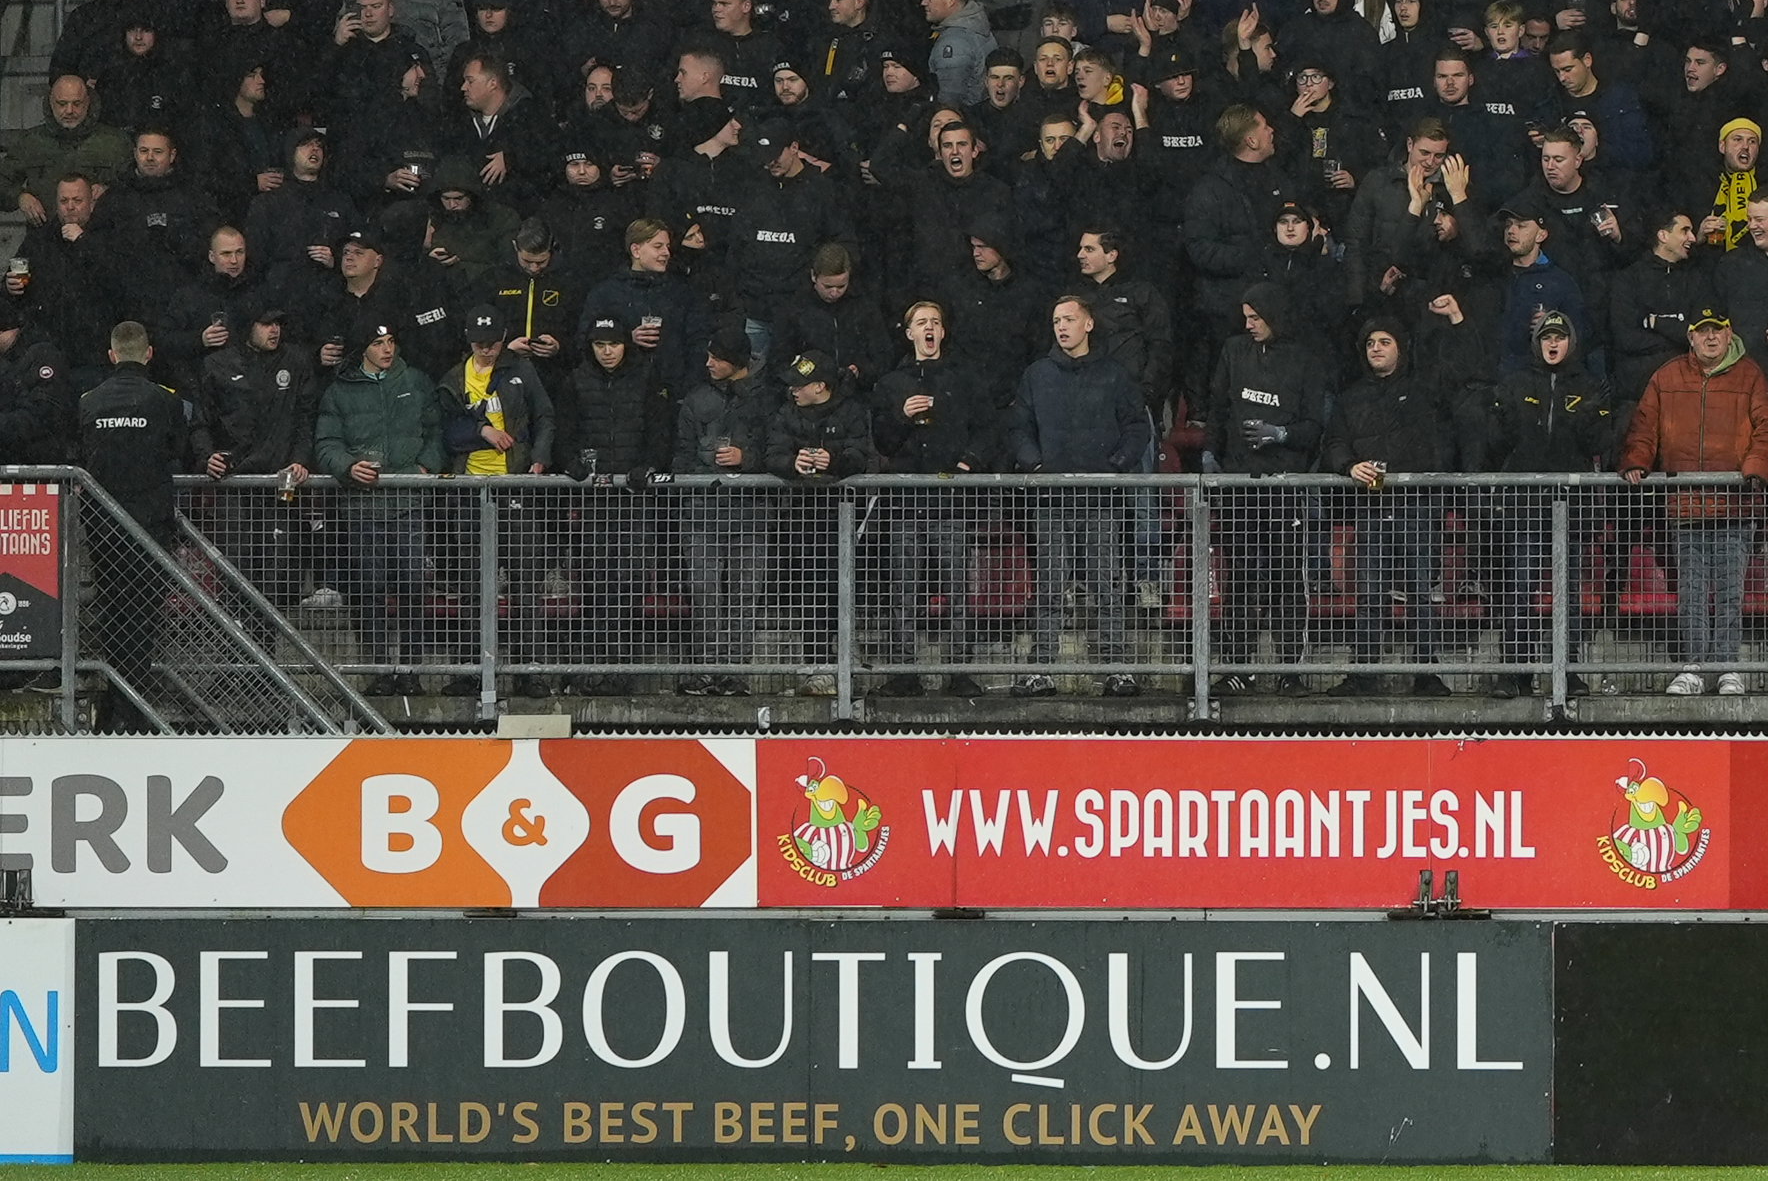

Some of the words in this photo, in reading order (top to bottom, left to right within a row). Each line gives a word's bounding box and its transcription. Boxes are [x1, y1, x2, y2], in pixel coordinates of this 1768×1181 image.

[1162, 135, 1204, 148] BREDA
[756, 229, 796, 244] BREDA
[95, 416, 148, 430] STEWARD
[1241, 387, 1281, 408] BREDA
[0, 509, 49, 531] LIEFDE
[0, 533, 51, 555] TAANS
[361, 774, 442, 874] B
[501, 798, 547, 847] &
[609, 774, 701, 874] G
[922, 788, 1536, 859] WWW.SPARTAANTJES.NL
[777, 834, 838, 887] KIDSCLUB
[841, 871, 853, 881] DE
[854, 825, 890, 877] SPARTAANTJES
[1596, 836, 1658, 890] KIDSCLUB
[1661, 873, 1673, 883] DE
[1674, 828, 1711, 880] SPARTAANTJES
[97, 950, 1524, 1089] BEEFBOUTIQUE.NL
[298, 1101, 541, 1145] WORLD'S
[563, 1102, 695, 1145] BEST
[714, 1102, 856, 1152] BEEF,
[872, 1103, 981, 1147] ONE
[1002, 1103, 1156, 1147] CLICK
[1171, 1103, 1323, 1147] AWAY
